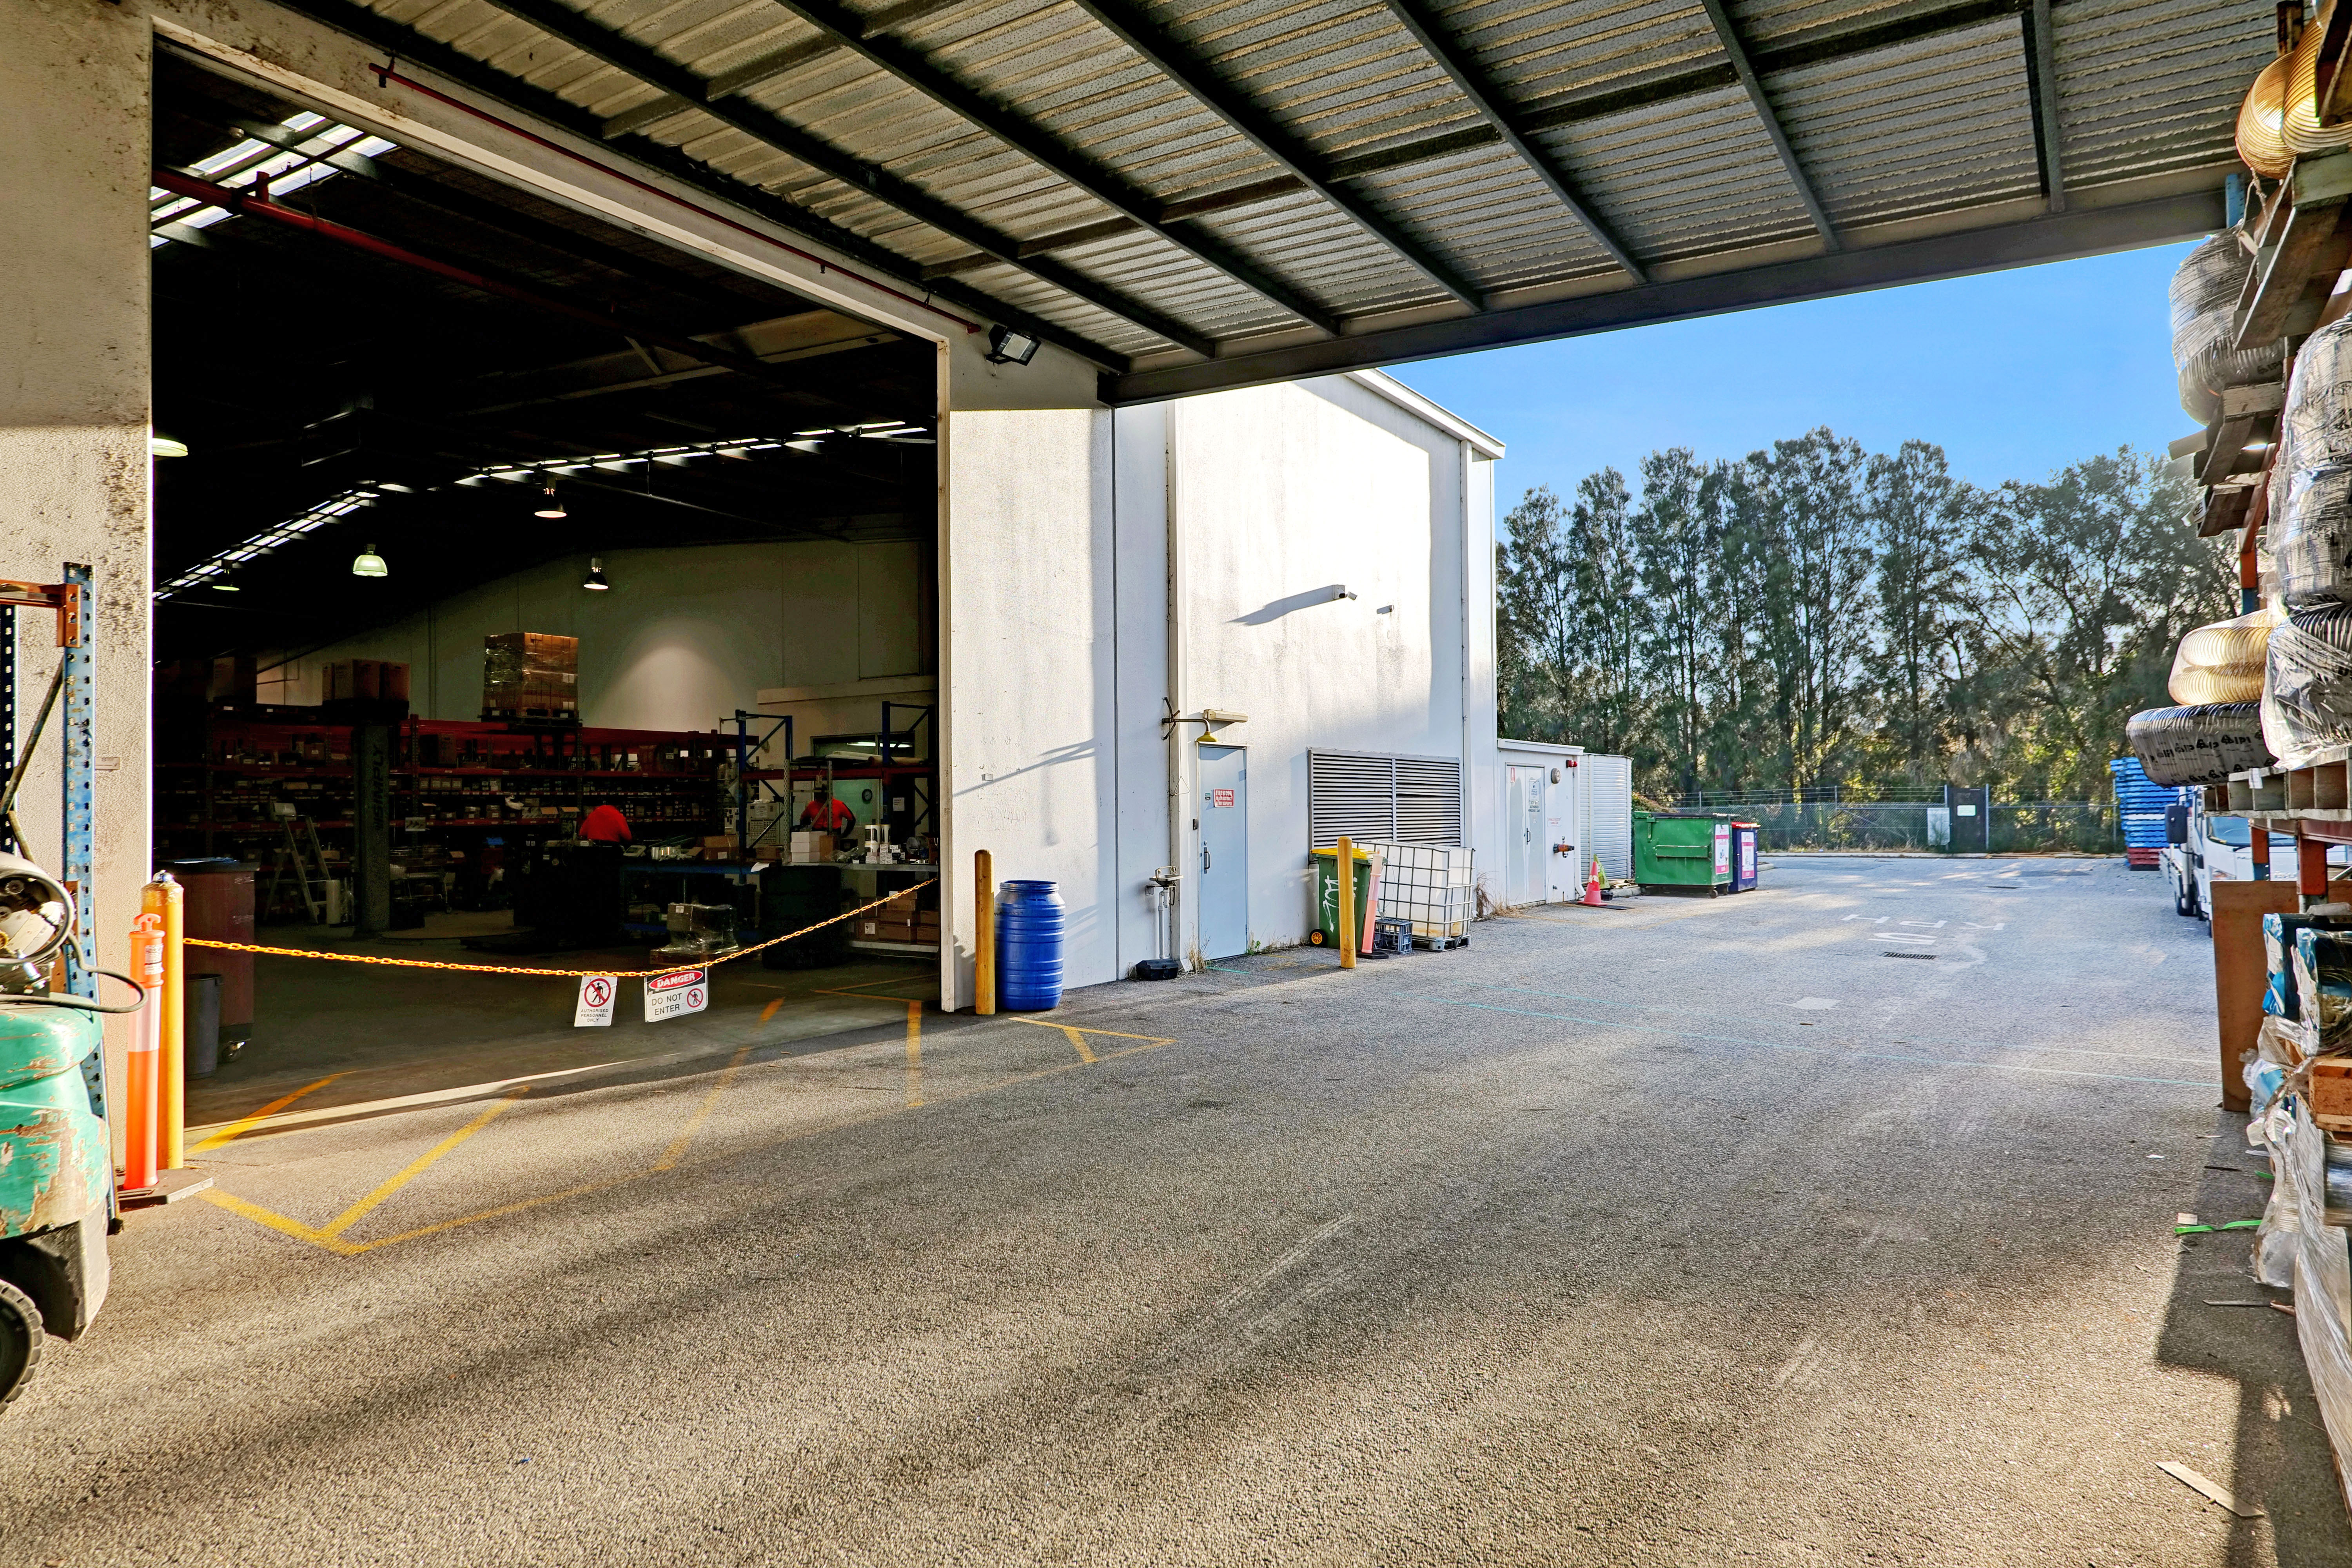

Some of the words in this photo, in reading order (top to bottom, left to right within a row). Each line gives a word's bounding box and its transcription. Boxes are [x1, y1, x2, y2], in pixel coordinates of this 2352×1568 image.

[657, 973, 695, 987] DANGER
[652, 997, 663, 1006] DO
[667, 993, 682, 1002] NOT
[655, 1004, 680, 1015] ENTER
